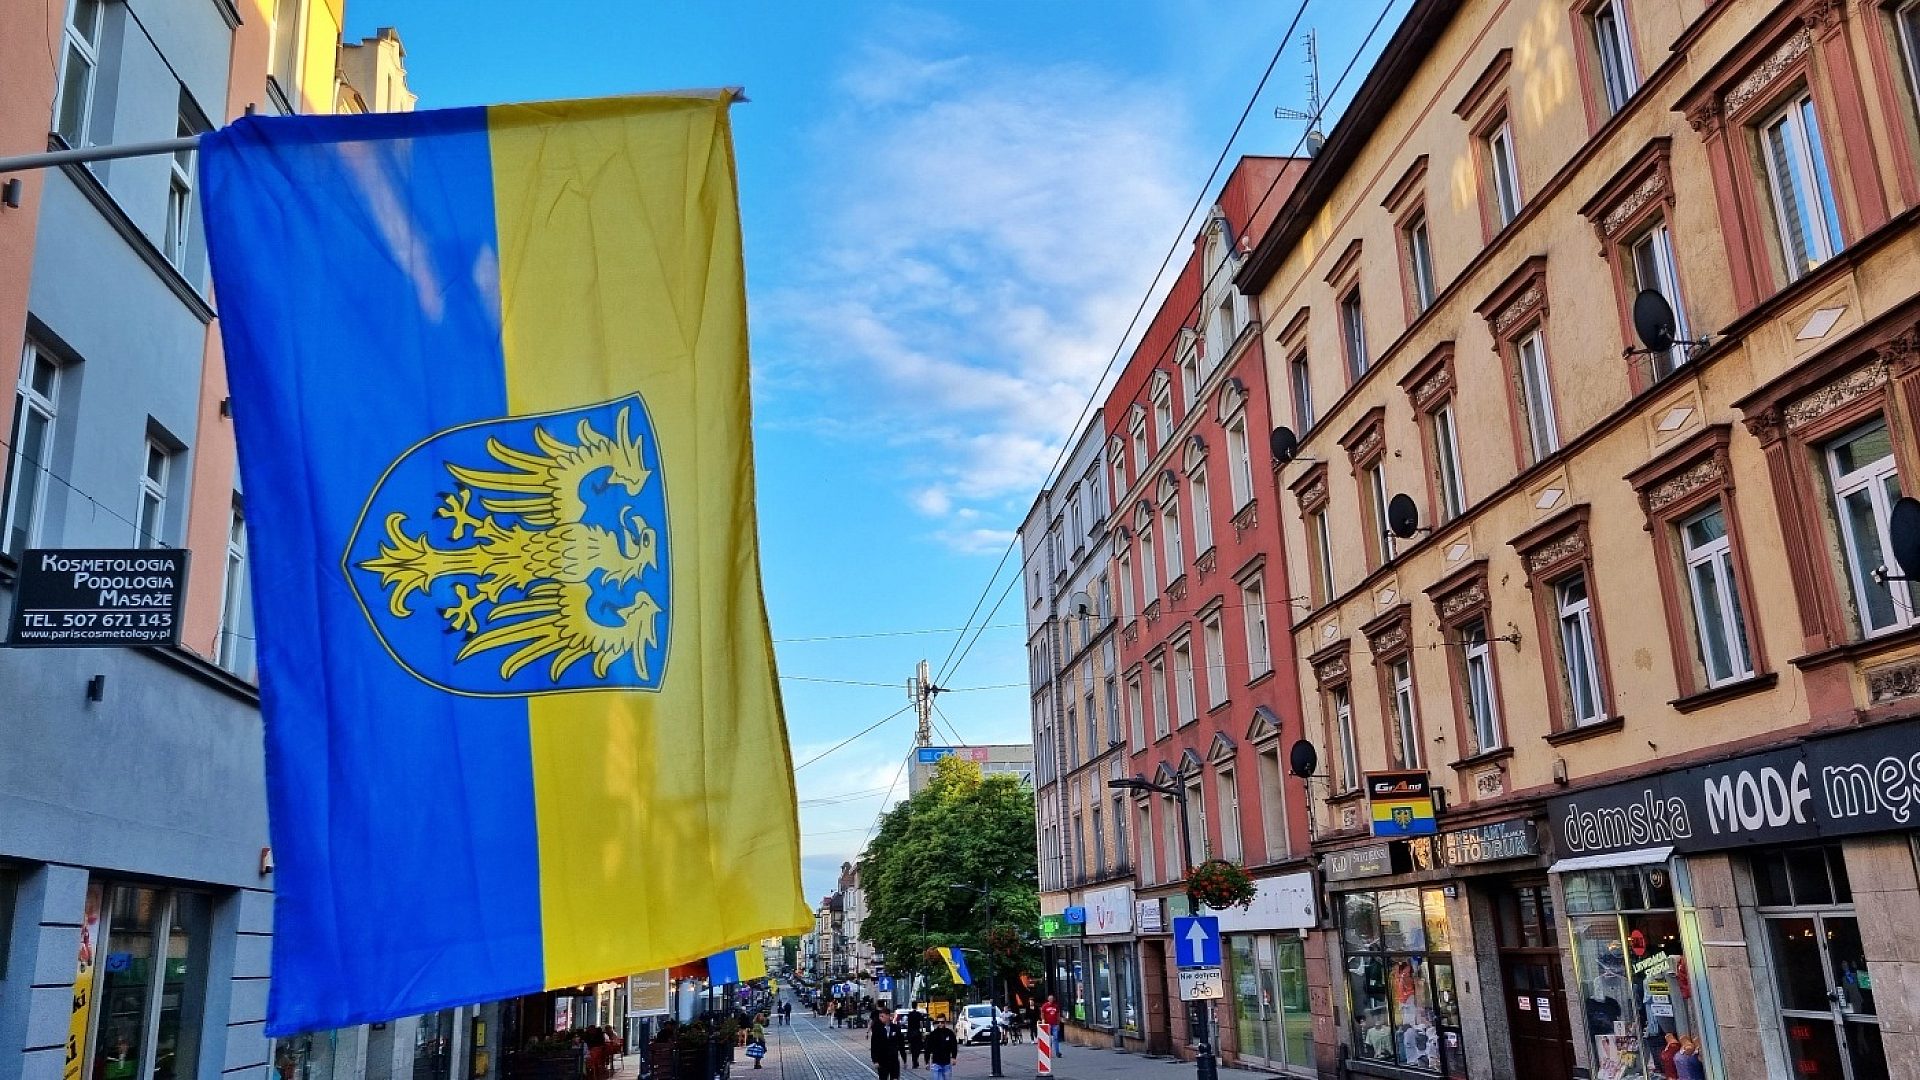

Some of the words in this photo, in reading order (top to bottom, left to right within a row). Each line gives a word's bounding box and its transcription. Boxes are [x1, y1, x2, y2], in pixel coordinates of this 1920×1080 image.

[41, 554, 175, 572] KOSMETOLOGIA
[73, 572, 174, 590] PODOLOGIA
[99, 589, 173, 607] MASAŻE
[23, 614, 57, 627] TEL.
[62, 614, 97, 627] 507
[102, 614, 134, 627] 671
[139, 614, 172, 627] 143
[21, 629, 171, 640] www.pariscosmetology.pl
[1564, 789, 1692, 851] damska
[1447, 836, 1529, 864] SITODRUK
[1180, 972, 1193, 980] Nie
